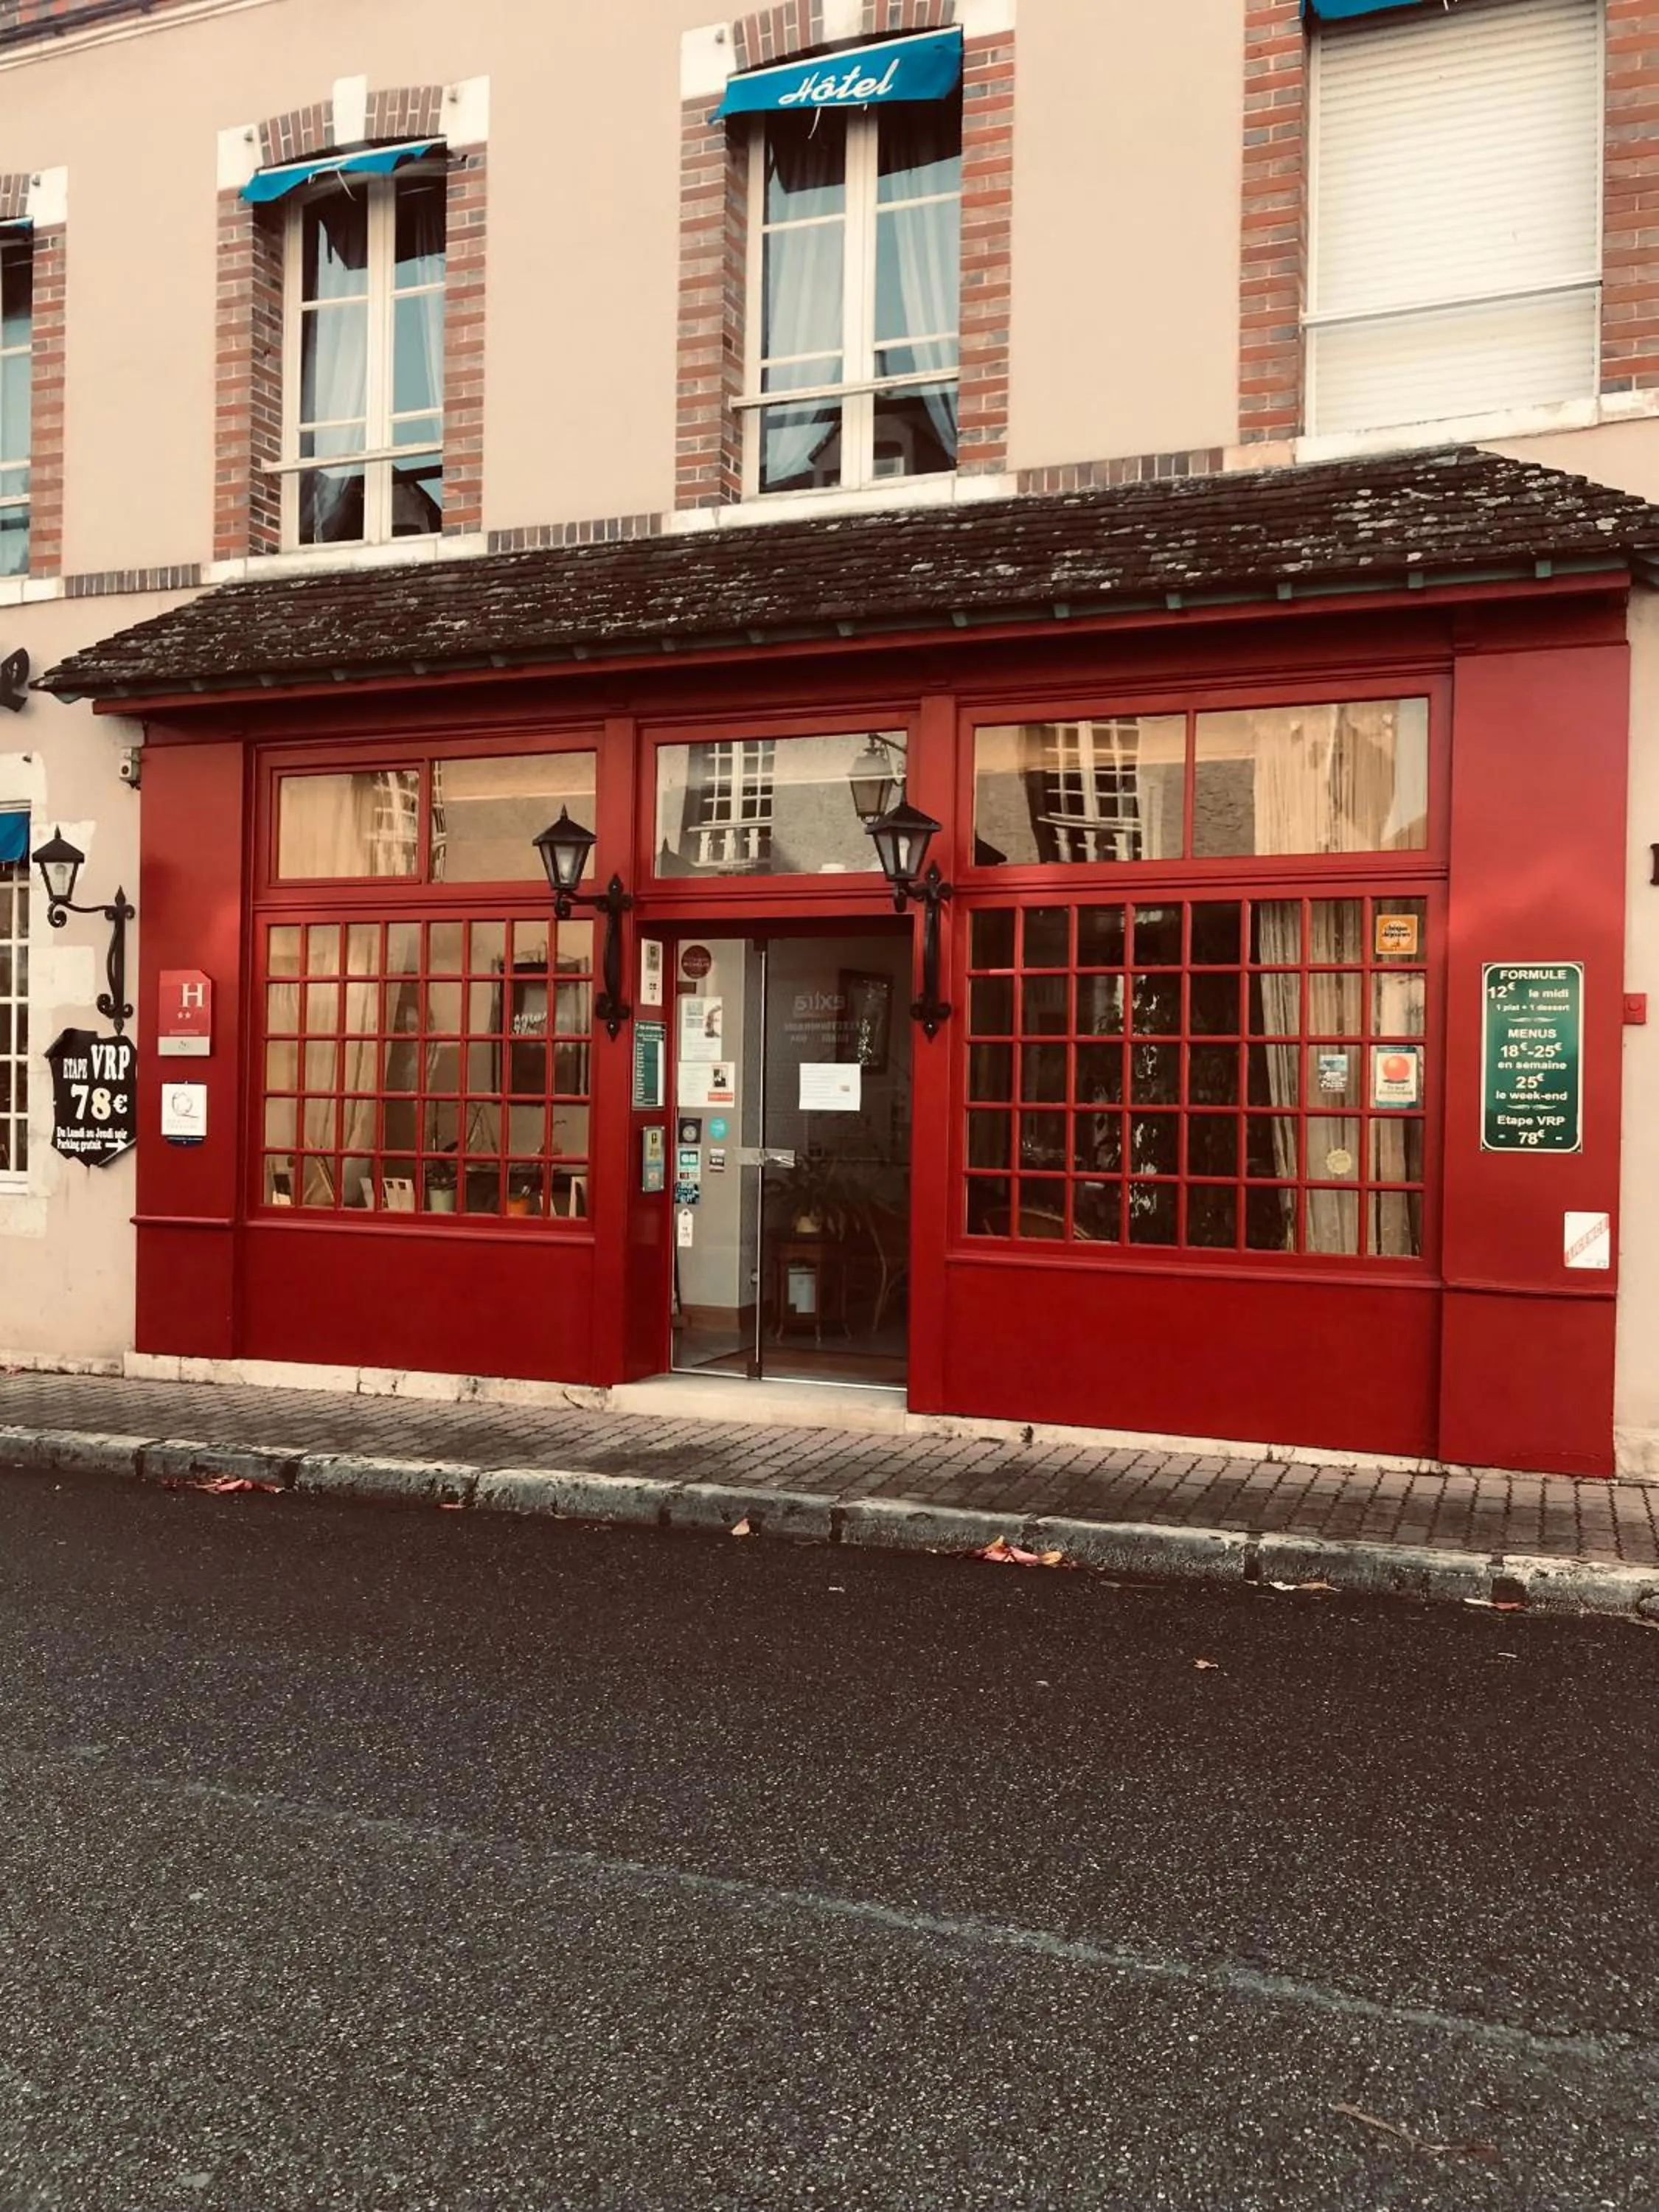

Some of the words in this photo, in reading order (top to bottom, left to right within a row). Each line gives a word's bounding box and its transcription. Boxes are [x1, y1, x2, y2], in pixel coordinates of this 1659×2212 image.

[779, 58, 900, 105] Hôtel
[1499, 970, 1567, 980] FORMULE
[181, 982, 204, 1007] H
[1488, 982, 1515, 999] 12€
[1528, 989, 1539, 998] le
[1543, 989, 1569, 998] midi
[1503, 1004, 1520, 1012] plat
[1508, 1029, 1557, 1039] MENUS
[63, 1058, 88, 1079] ETAPE
[91, 1044, 131, 1080] VRP
[1515, 1060, 1567, 1070] semaine
[1515, 1073, 1545, 1089] 25€
[71, 1084, 128, 1121] 78€
[1495, 1090, 1506, 1099] le
[1509, 1091, 1568, 1101] week-end
[1497, 1114, 1534, 1127] Etape
[1537, 1116, 1565, 1126] VRP
[66, 1127, 85, 1138] Lundi
[95, 1127, 114, 1139] Jeudi
[1518, 1129, 1545, 1145] 78€
[57, 1138, 80, 1152] Parking
[80, 1139, 102, 1152] gratuit
